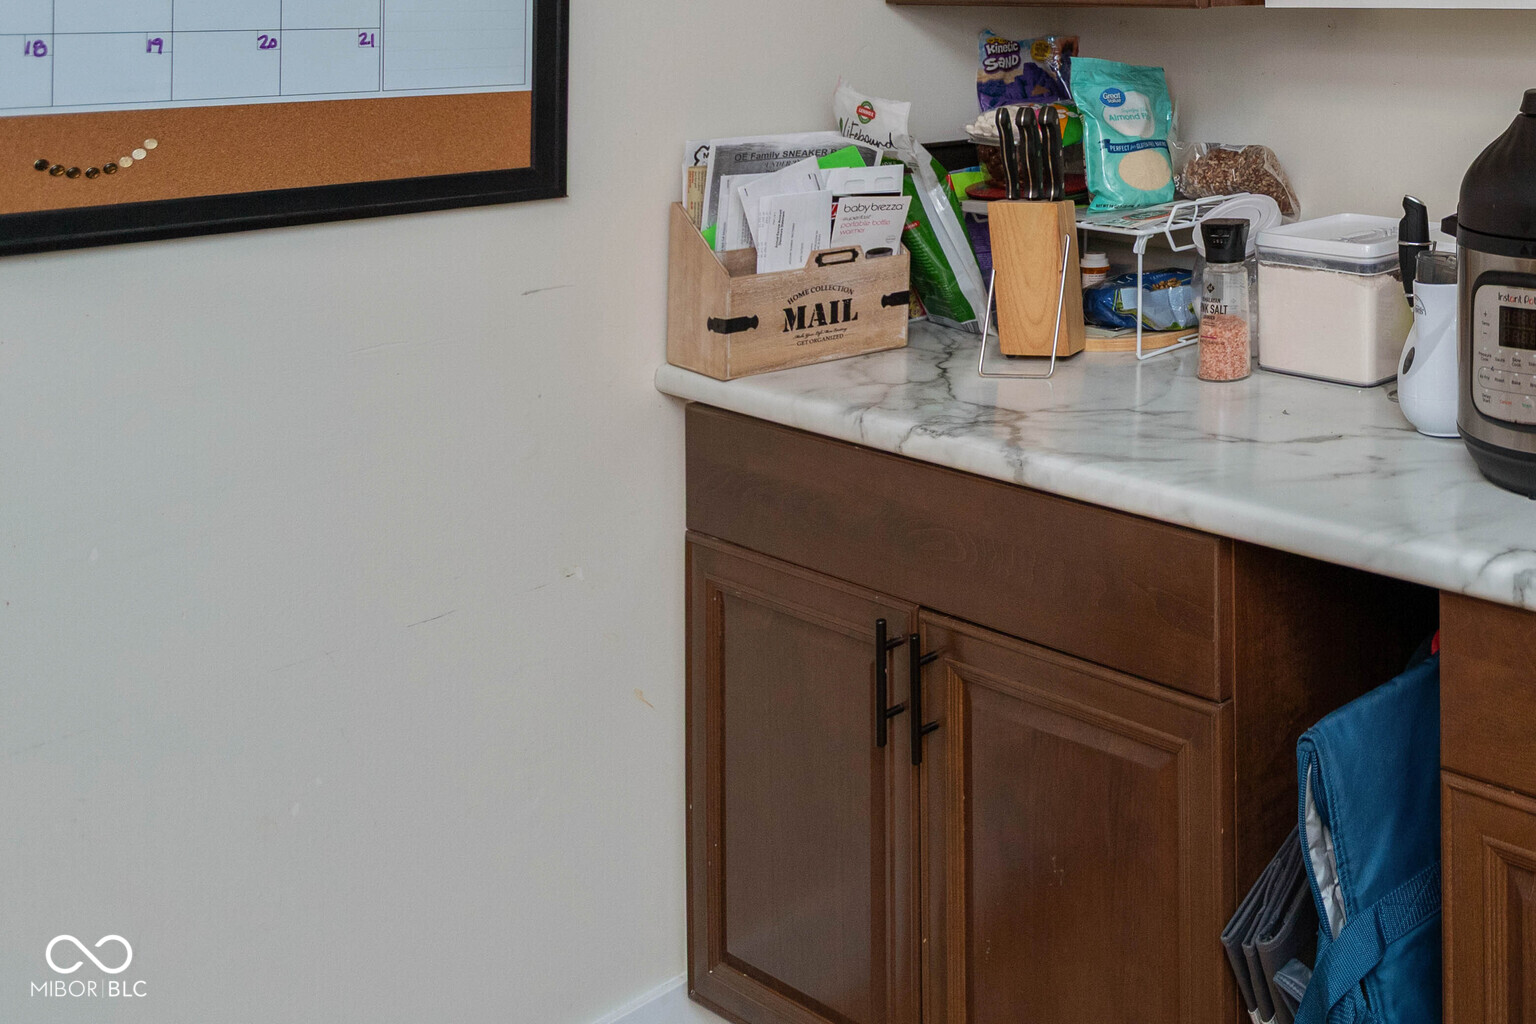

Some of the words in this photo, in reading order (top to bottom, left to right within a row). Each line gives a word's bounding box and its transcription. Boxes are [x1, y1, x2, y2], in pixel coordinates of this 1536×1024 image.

[24, 39, 48, 57] 18
[146, 37, 163, 54] 19
[257, 34, 278, 49] 20
[359, 32, 375, 48] 21
[985, 41, 1019, 55] Kinetic
[1103, 92, 1121, 100] Great
[1109, 113, 1140, 121] Almond
[1110, 144, 1130, 152] PERFECT
[750, 151, 780, 161] Family
[782, 148, 829, 158] SNEAKER
[844, 203, 869, 213] baby
[870, 202, 903, 211] brezza
[840, 220, 871, 228] portable
[787, 289, 810, 305] HOME
[811, 284, 855, 295] COLLECTION
[1498, 292, 1522, 304] Instant
[1524, 295, 1536, 305] Pot
[1211, 305, 1228, 314] SALT
[783, 298, 858, 333] MAIL
[809, 334, 844, 344] ORGANIZED
